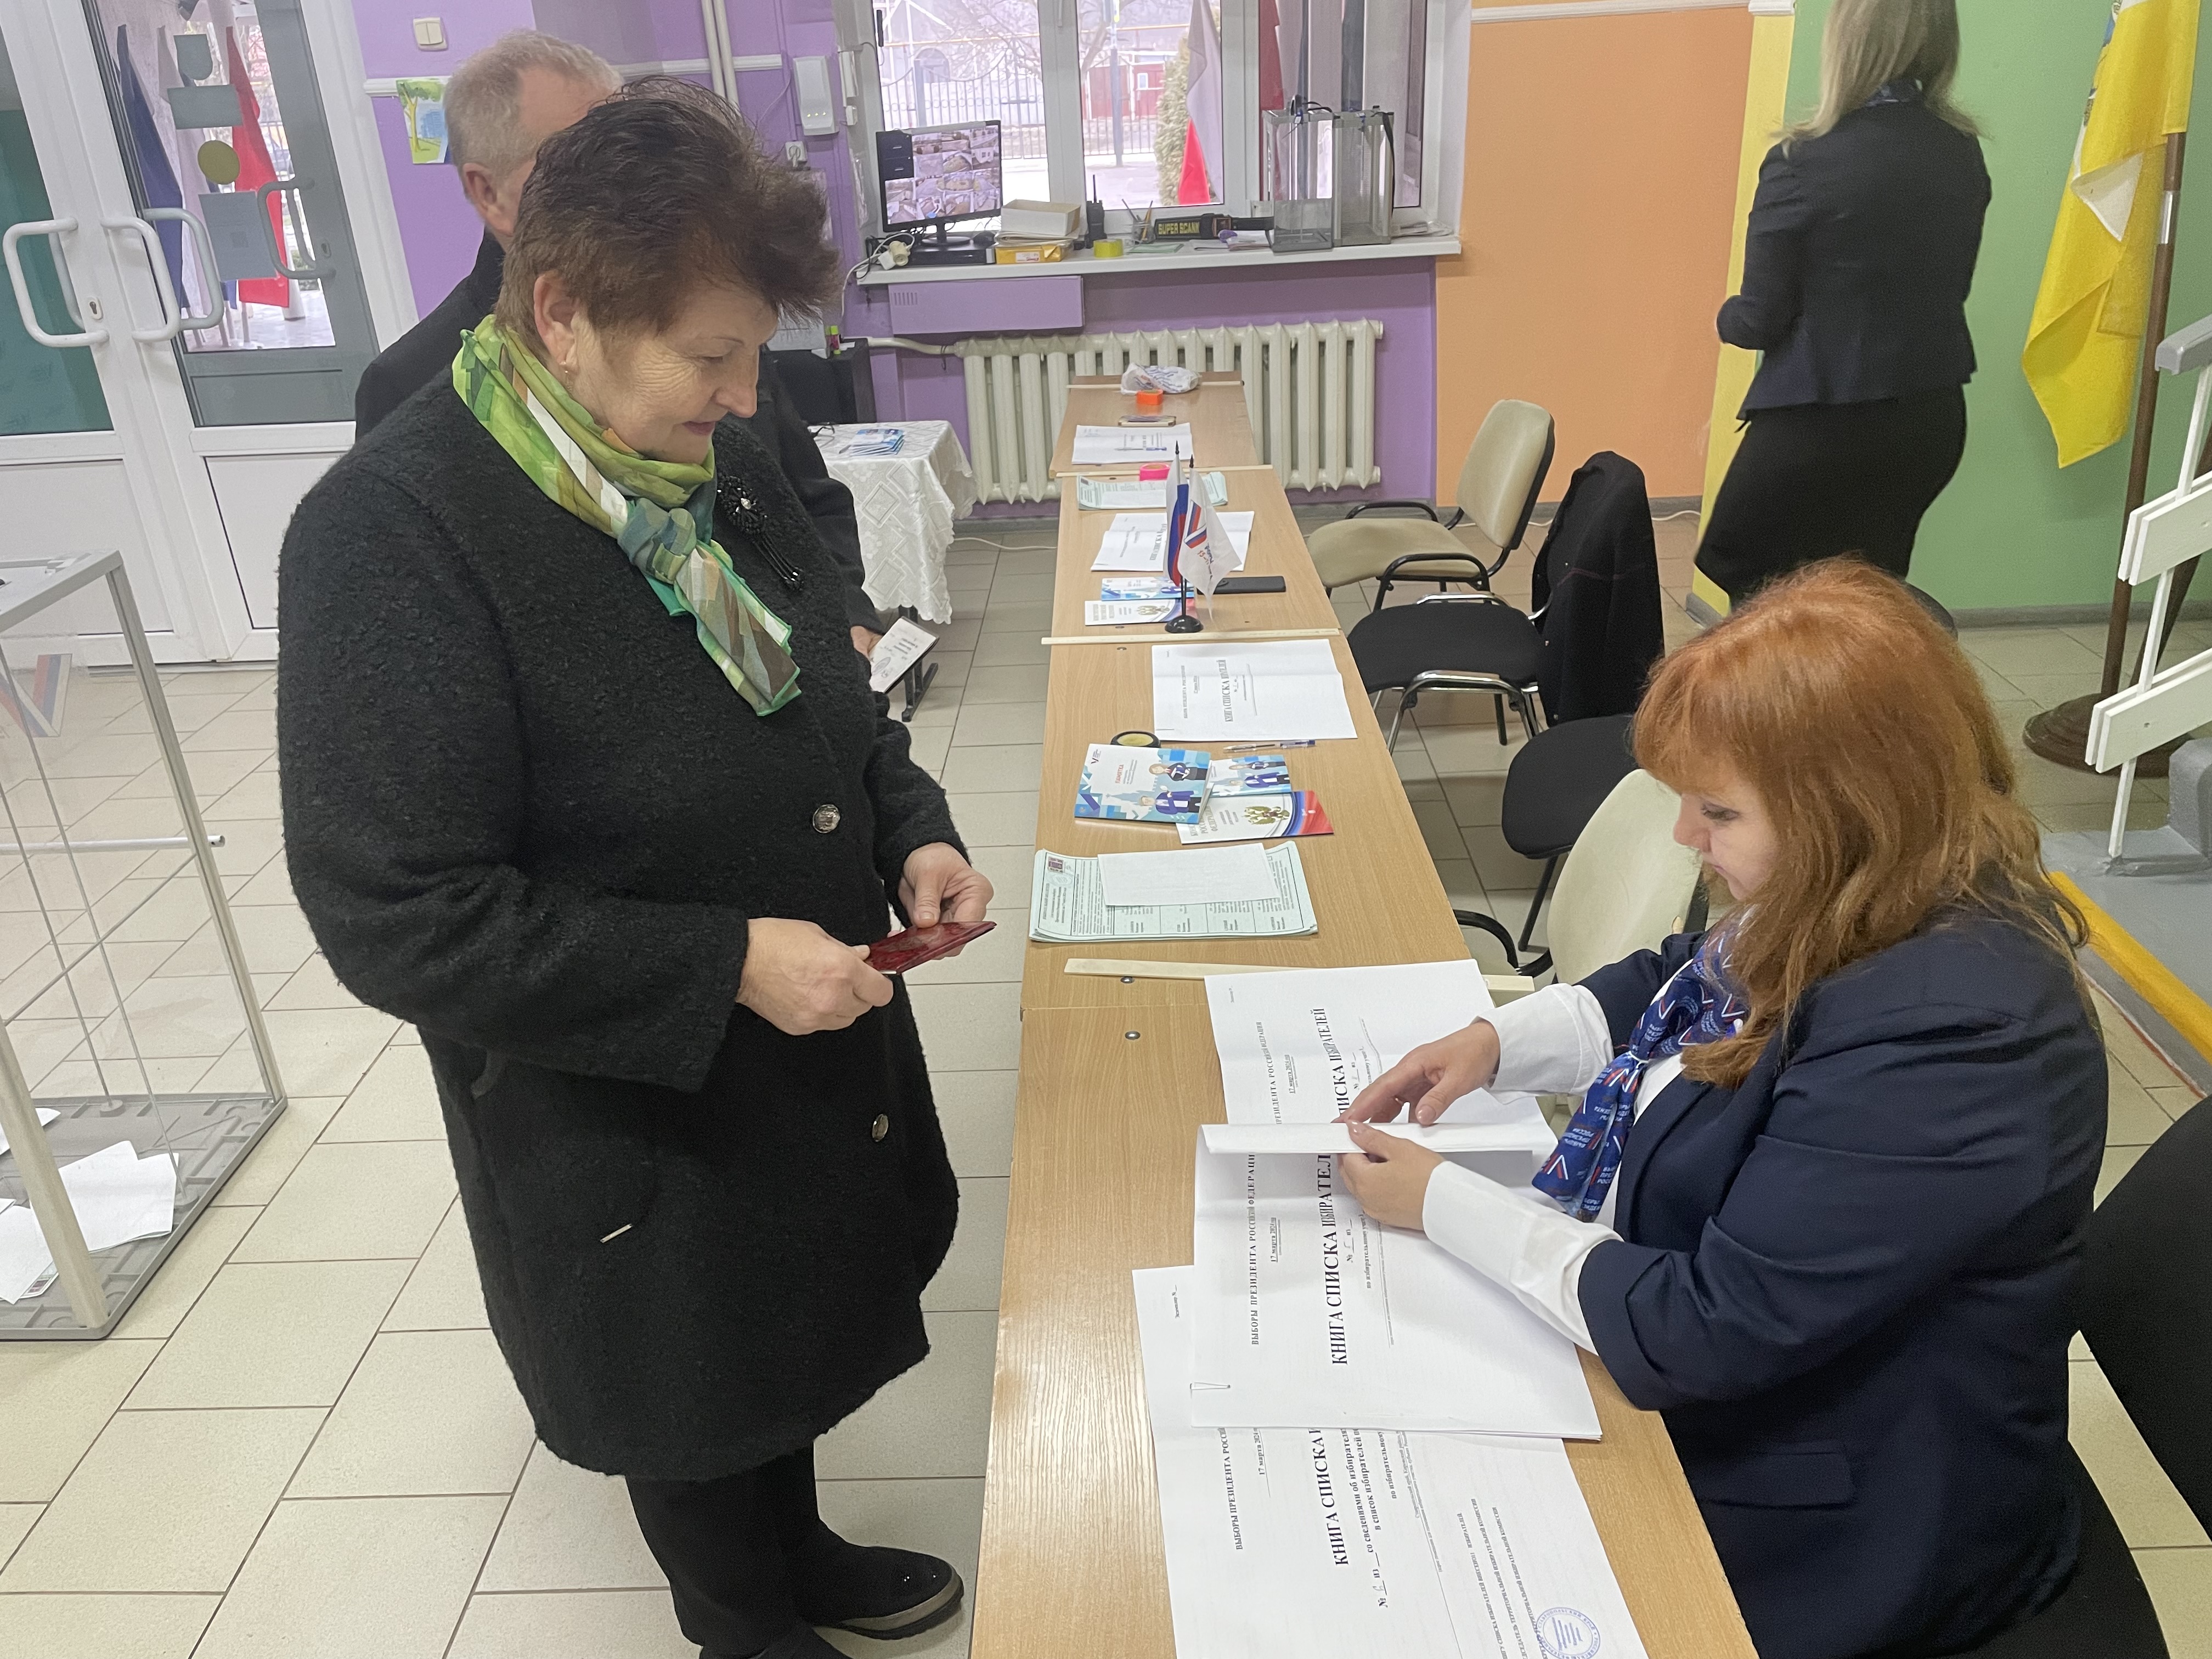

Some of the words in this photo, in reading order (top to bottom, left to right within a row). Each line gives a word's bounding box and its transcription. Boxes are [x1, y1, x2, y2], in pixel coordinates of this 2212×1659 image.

[1249, 1245, 1258, 1305] ПРЕЗИДЕНТА
[1323, 1231, 1342, 1307] СПИСКА
[1250, 1310, 1259, 1345] ВЫБОРЫ
[1328, 1311, 1348, 1365] КНИГА
[1311, 1437, 1336, 1508] СПИСКА
[1353, 1436, 1372, 1493] избирателей
[1377, 1431, 1395, 1489] избирательному
[1223, 1456, 1237, 1514] ПРЕЗИДЕНТА
[1349, 1481, 1358, 1492] об
[1367, 1494, 1382, 1523] список
[1390, 1491, 1397, 1499] по
[1230, 1515, 1243, 1550] ВЫБОРЫ
[1325, 1511, 1349, 1566] КНИГА
[1353, 1493, 1373, 1542] сведениями
[1365, 1544, 1374, 1553] со
[1372, 1569, 1380, 1578] из
[1378, 1598, 1388, 1608] №
